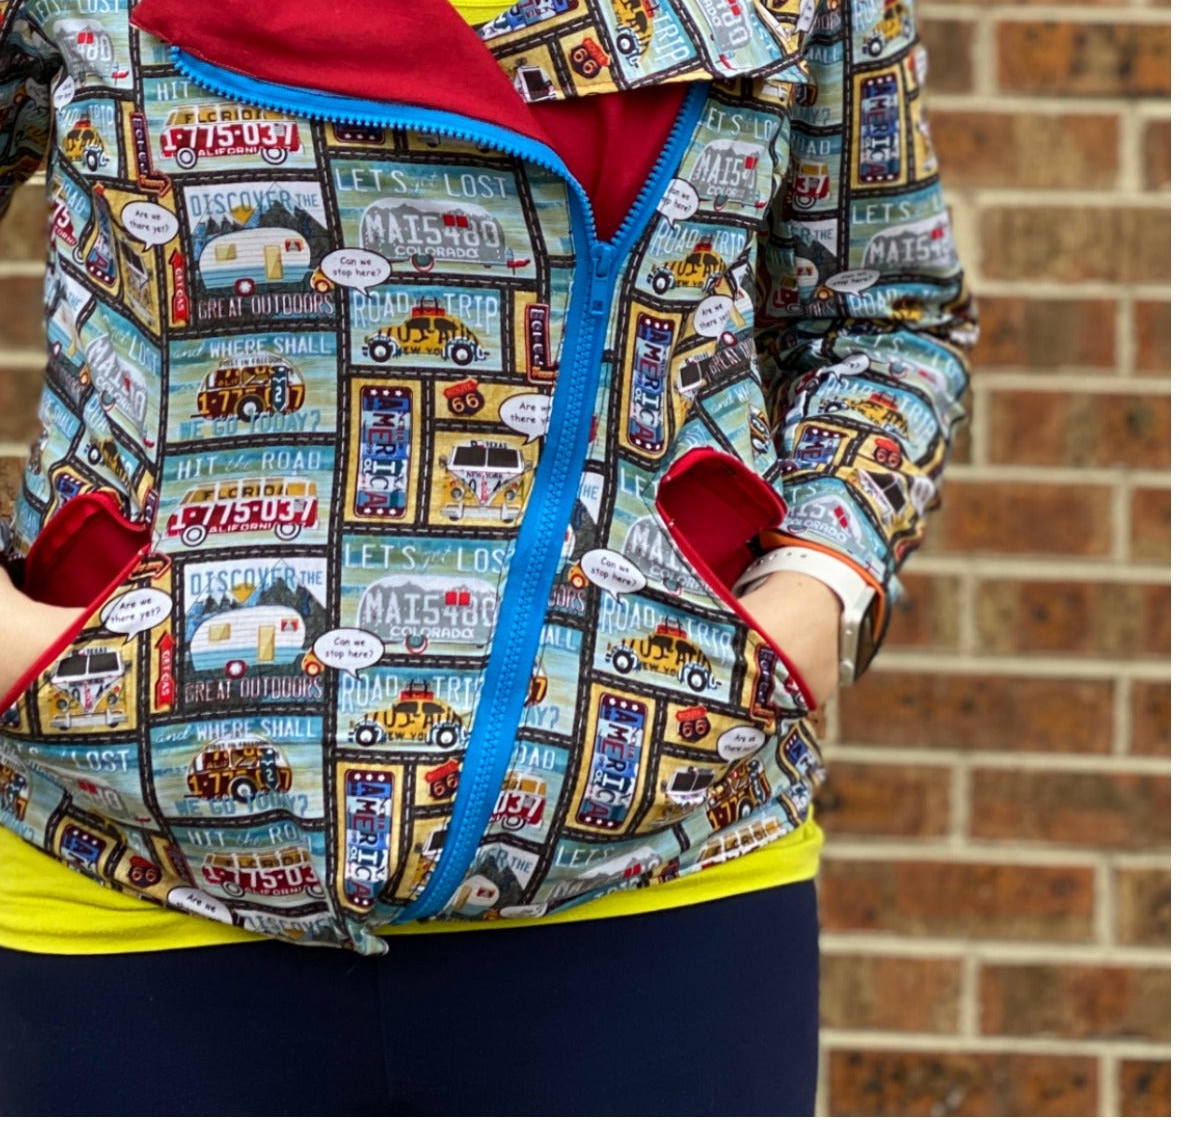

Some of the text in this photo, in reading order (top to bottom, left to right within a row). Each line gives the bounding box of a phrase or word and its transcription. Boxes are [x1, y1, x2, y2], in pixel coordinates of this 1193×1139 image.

[652, 11, 690, 62] TRIP
[573, 47, 596, 74] 66
[158, 81, 191, 100] HIT
[444, 173, 507, 199] LOST
[190, 190, 319, 216] DISCOVER THE
[135, 210, 149, 220] Are
[130, 220, 170, 234] there yet?
[815, 229, 833, 240] THE
[651, 220, 698, 256] ROAD
[394, 245, 479, 258] COLORADO
[340, 257, 358, 266] Can
[333, 267, 381, 277] stop here?
[198, 293, 334, 320] GREAT OUTDOORS
[352, 291, 499, 334] ROAD TRIP
[173, 335, 331, 360] and WHERE SHALL
[452, 393, 479, 412] 66
[520, 403, 536, 411] Are
[180, 410, 322, 439] WE GO TODAY?
[510, 414, 536, 423] there
[178, 451, 322, 480] HIT the ROAD
[876, 448, 901, 466] 66
[601, 557, 629, 573] Can we
[191, 568, 322, 596] DISCOVER THE
[591, 567, 637, 587] stop here?
[120, 597, 152, 609] Are we
[111, 608, 161, 624] there yet?
[390, 627, 475, 638] COLORADO
[601, 593, 731, 663] ROAD TRIP
[334, 637, 350, 646] Can
[325, 649, 374, 659] stop here?
[185, 676, 323, 704] GREAT OUTDOORS
[341, 673, 398, 712] ROAD
[156, 720, 317, 742] and WHERE SHALL
[682, 720, 708, 735] 66
[71, 749, 130, 773] LOST
[210, 797, 236, 814] GO
[188, 832, 225, 847] HIT
[131, 869, 156, 882] 66
[187, 894, 202, 906] Are
